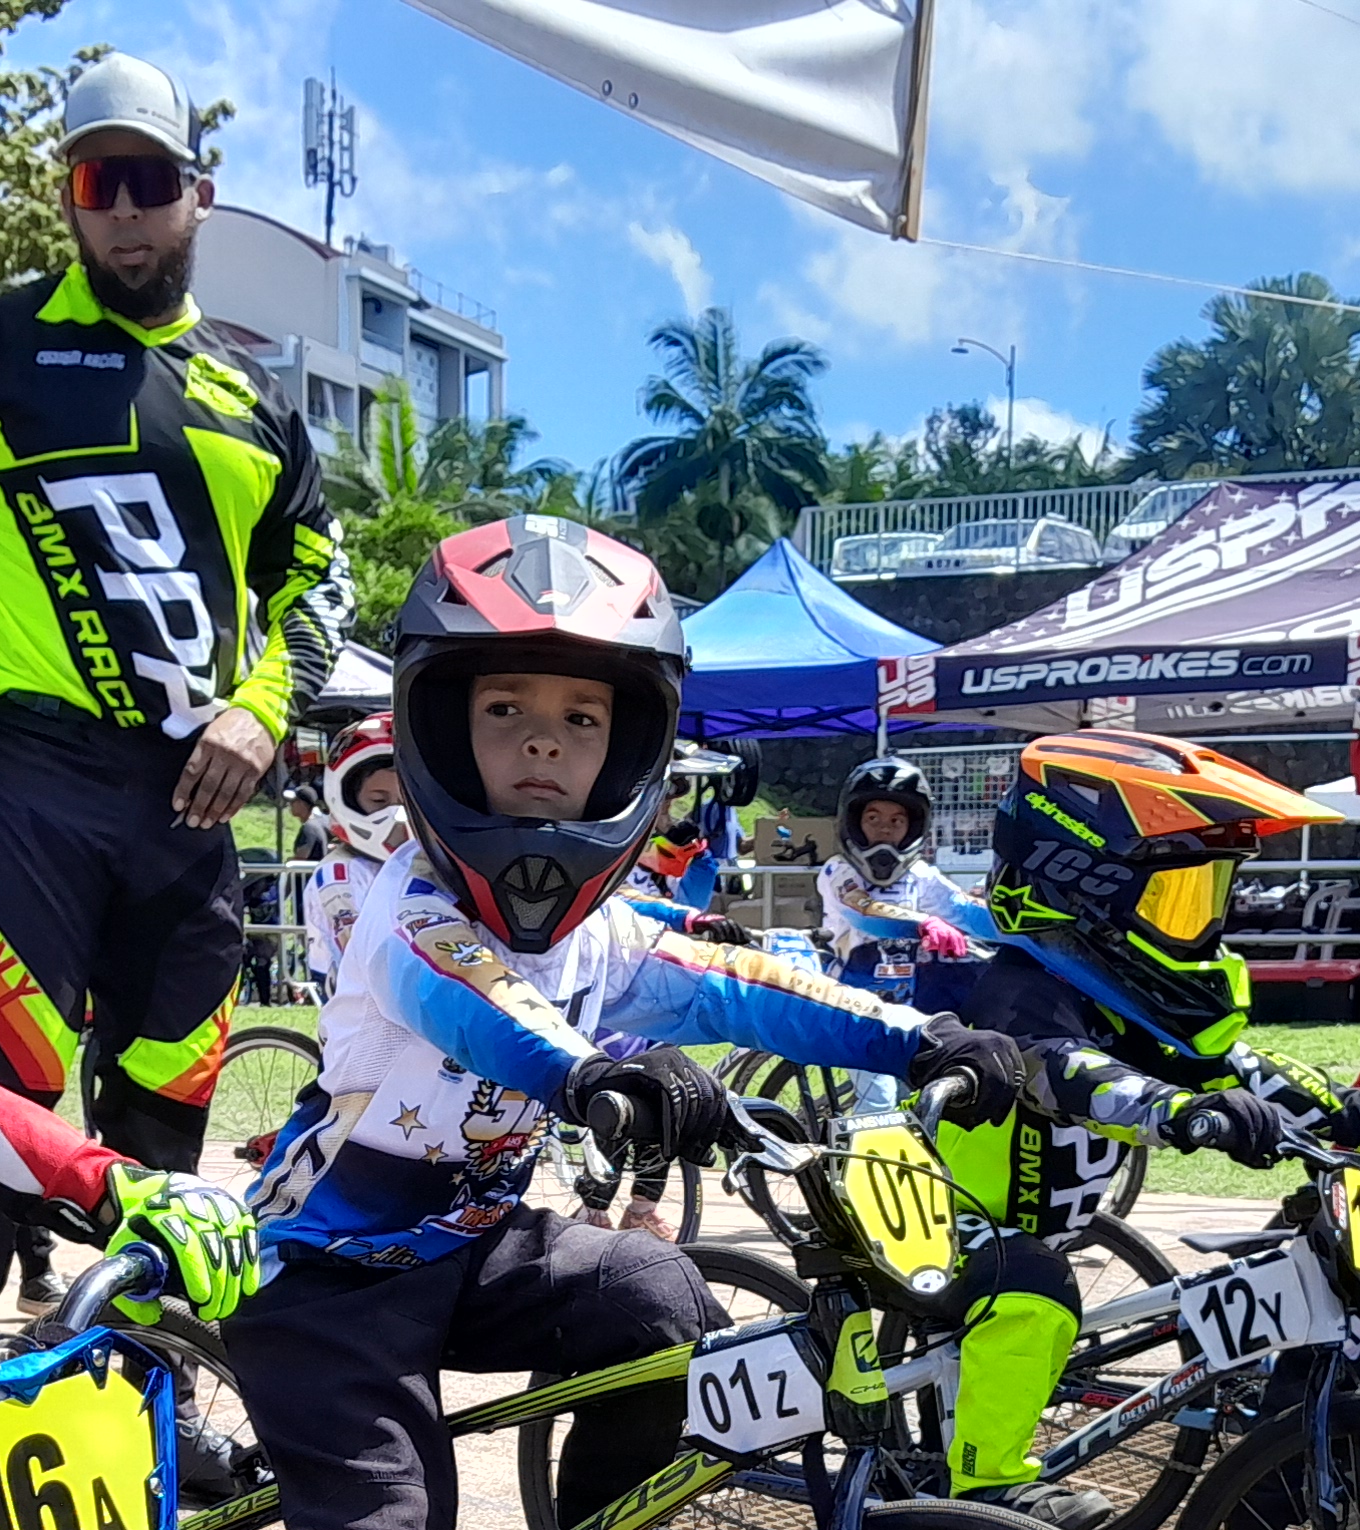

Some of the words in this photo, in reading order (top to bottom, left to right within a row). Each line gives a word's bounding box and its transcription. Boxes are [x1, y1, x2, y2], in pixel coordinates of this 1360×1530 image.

[17, 491, 89, 599] BMX
[69, 608, 147, 729] RACE
[1024, 792, 1106, 848] alpinestars
[846, 1112, 907, 1132] ANSWER
[1021, 1123, 1043, 1205] BMX
[1199, 1277, 1288, 1362] 12Y
